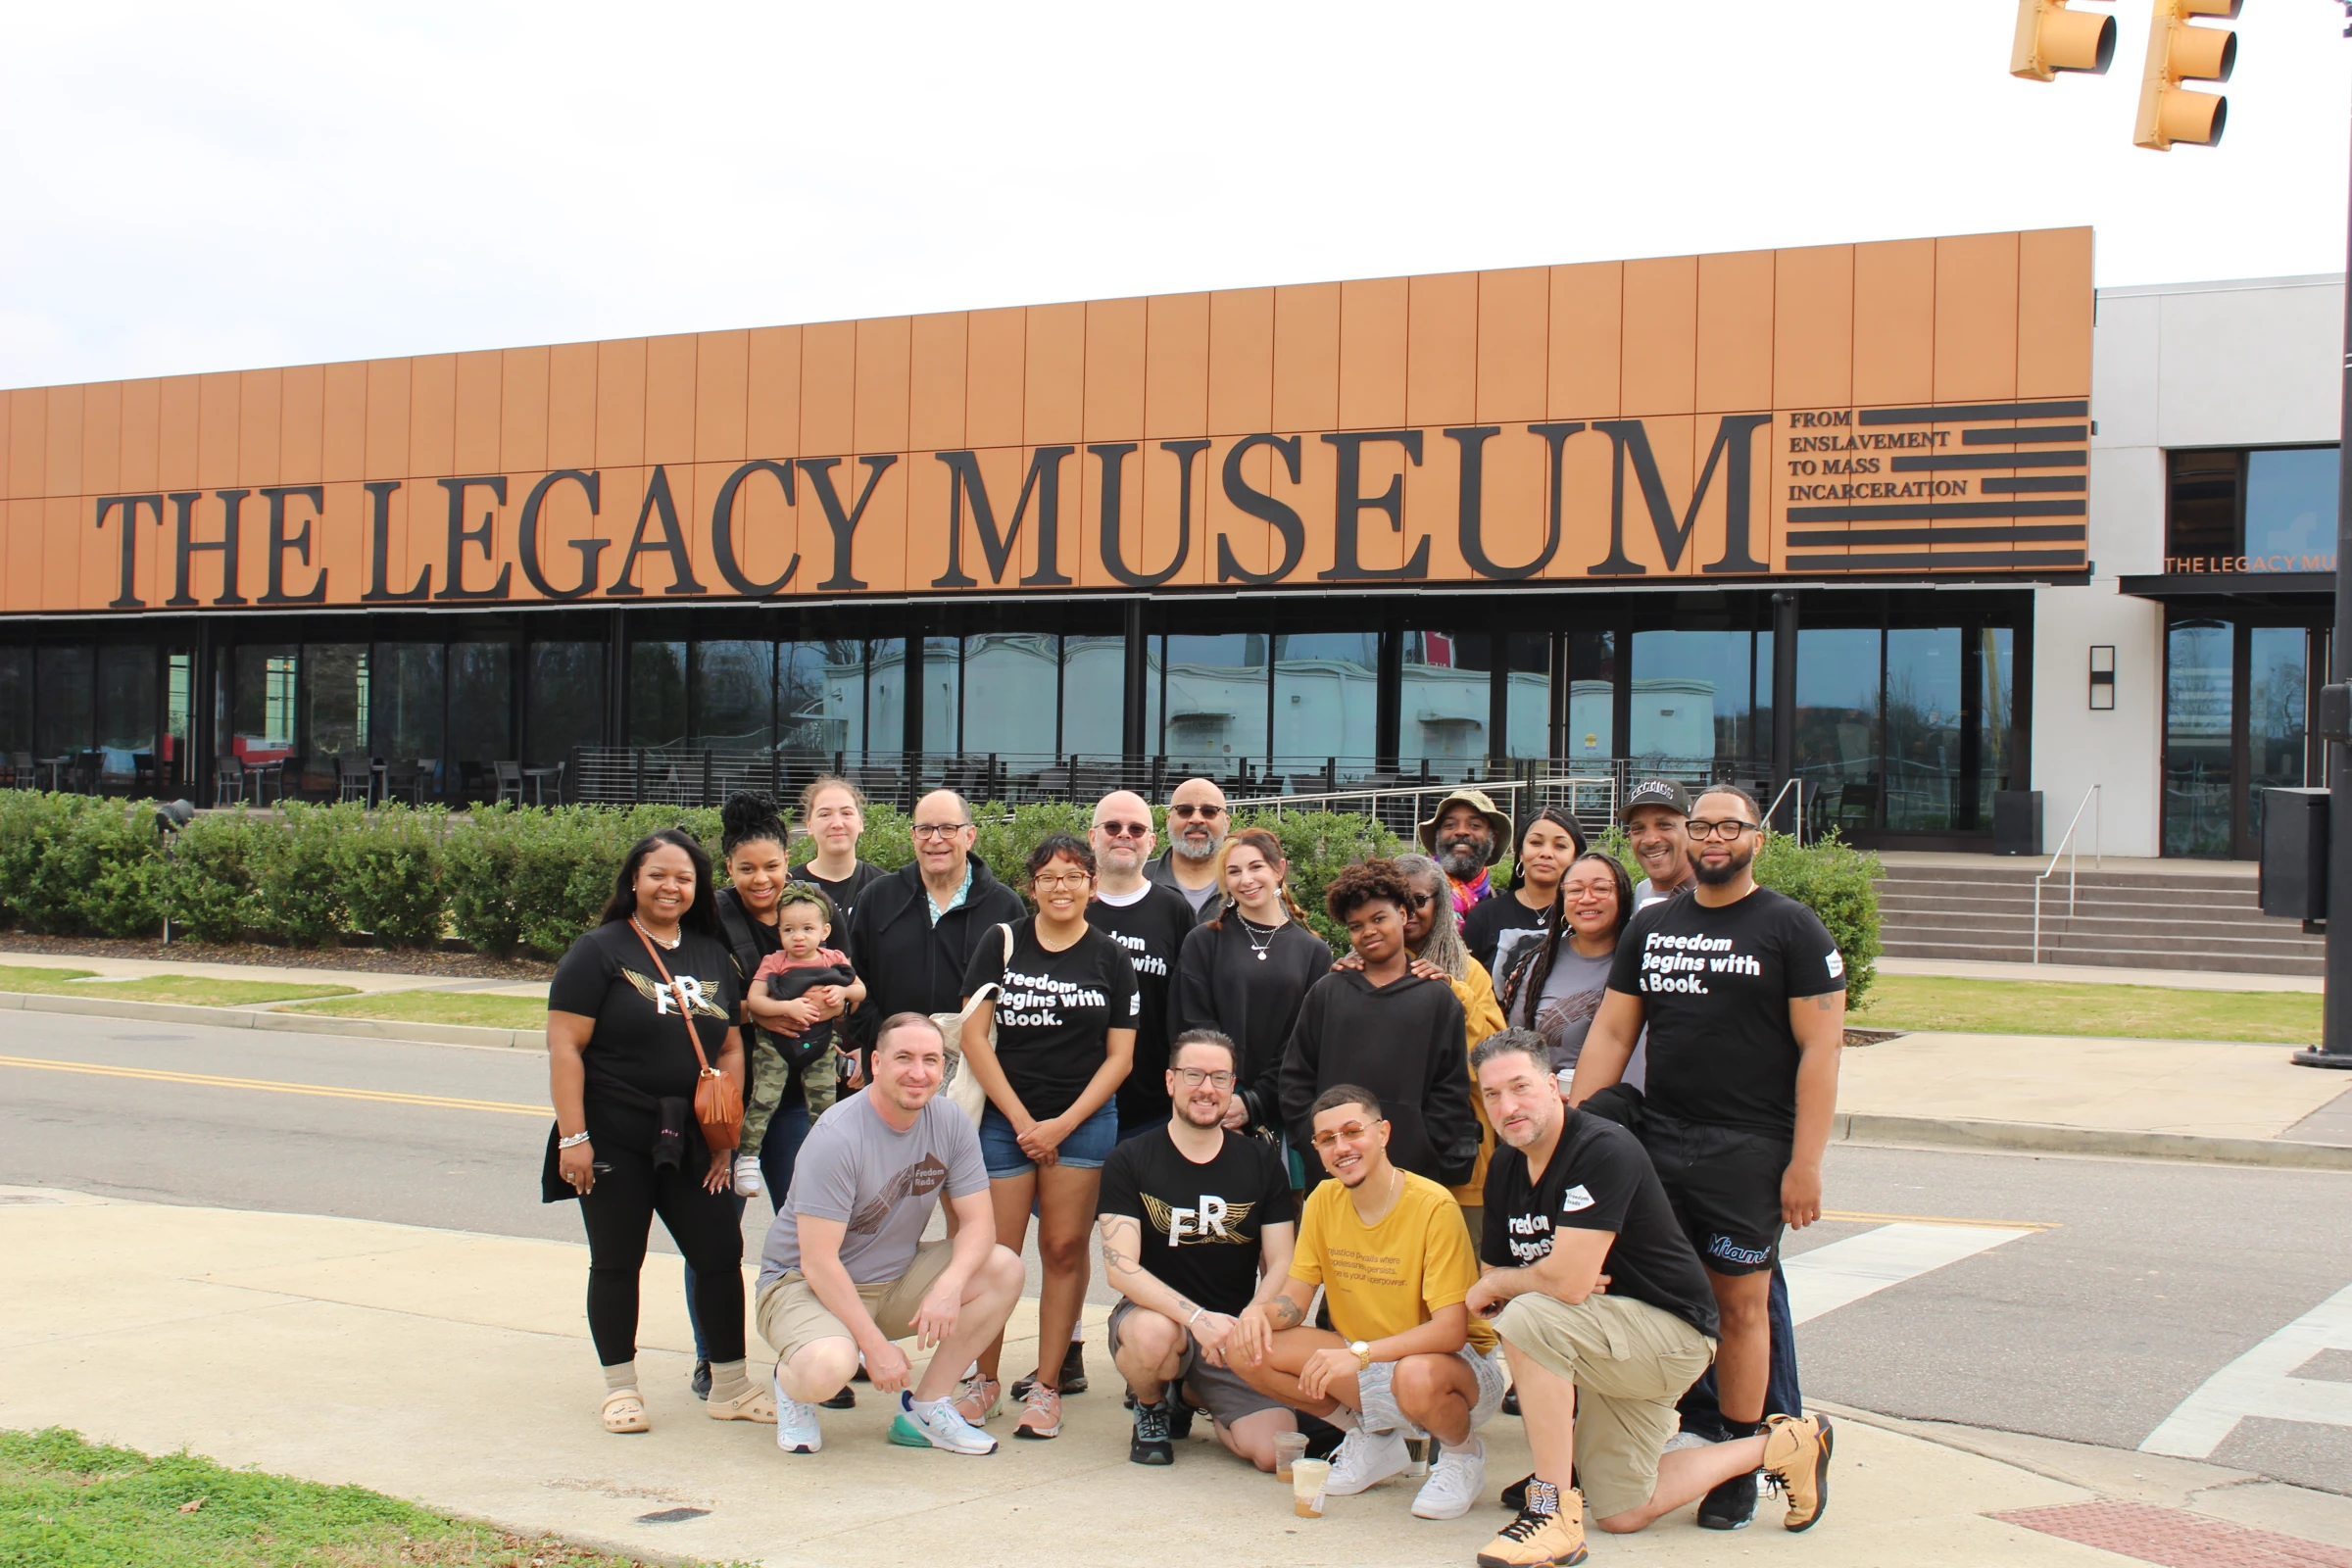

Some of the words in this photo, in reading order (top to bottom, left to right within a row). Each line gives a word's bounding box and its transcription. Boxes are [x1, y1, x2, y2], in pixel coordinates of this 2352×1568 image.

[1789, 410, 1851, 428] FROM
[1788, 430, 1951, 453] ENSLAVEMENT
[1788, 460, 1817, 476] TO
[1822, 457, 1880, 475] MASS
[1788, 479, 1969, 501] INCARCERATION
[96, 485, 328, 608] THE
[362, 454, 899, 603] LEGACY
[930, 414, 1773, 588] MUSEUM
[2164, 557, 2205, 573] THE
[2210, 555, 2298, 573] LEGACY
[2301, 554, 2337, 571] MU
[1644, 932, 1733, 952] Freedom
[1130, 954, 1167, 976] with
[1642, 952, 1706, 974] Begins
[1709, 954, 1761, 976] with
[1639, 977, 1649, 992] a
[1649, 972, 1709, 995] Book.
[1060, 989, 1105, 1007] with
[1004, 1009, 1063, 1027] Book.
[1168, 1195, 1228, 1248] FR
[1327, 1247, 1355, 1258] njustice
[1379, 1255, 1400, 1264] where
[1707, 1233, 1772, 1264] Miami
[1349, 1272, 1367, 1281] your
[1367, 1263, 1397, 1275] persists.
